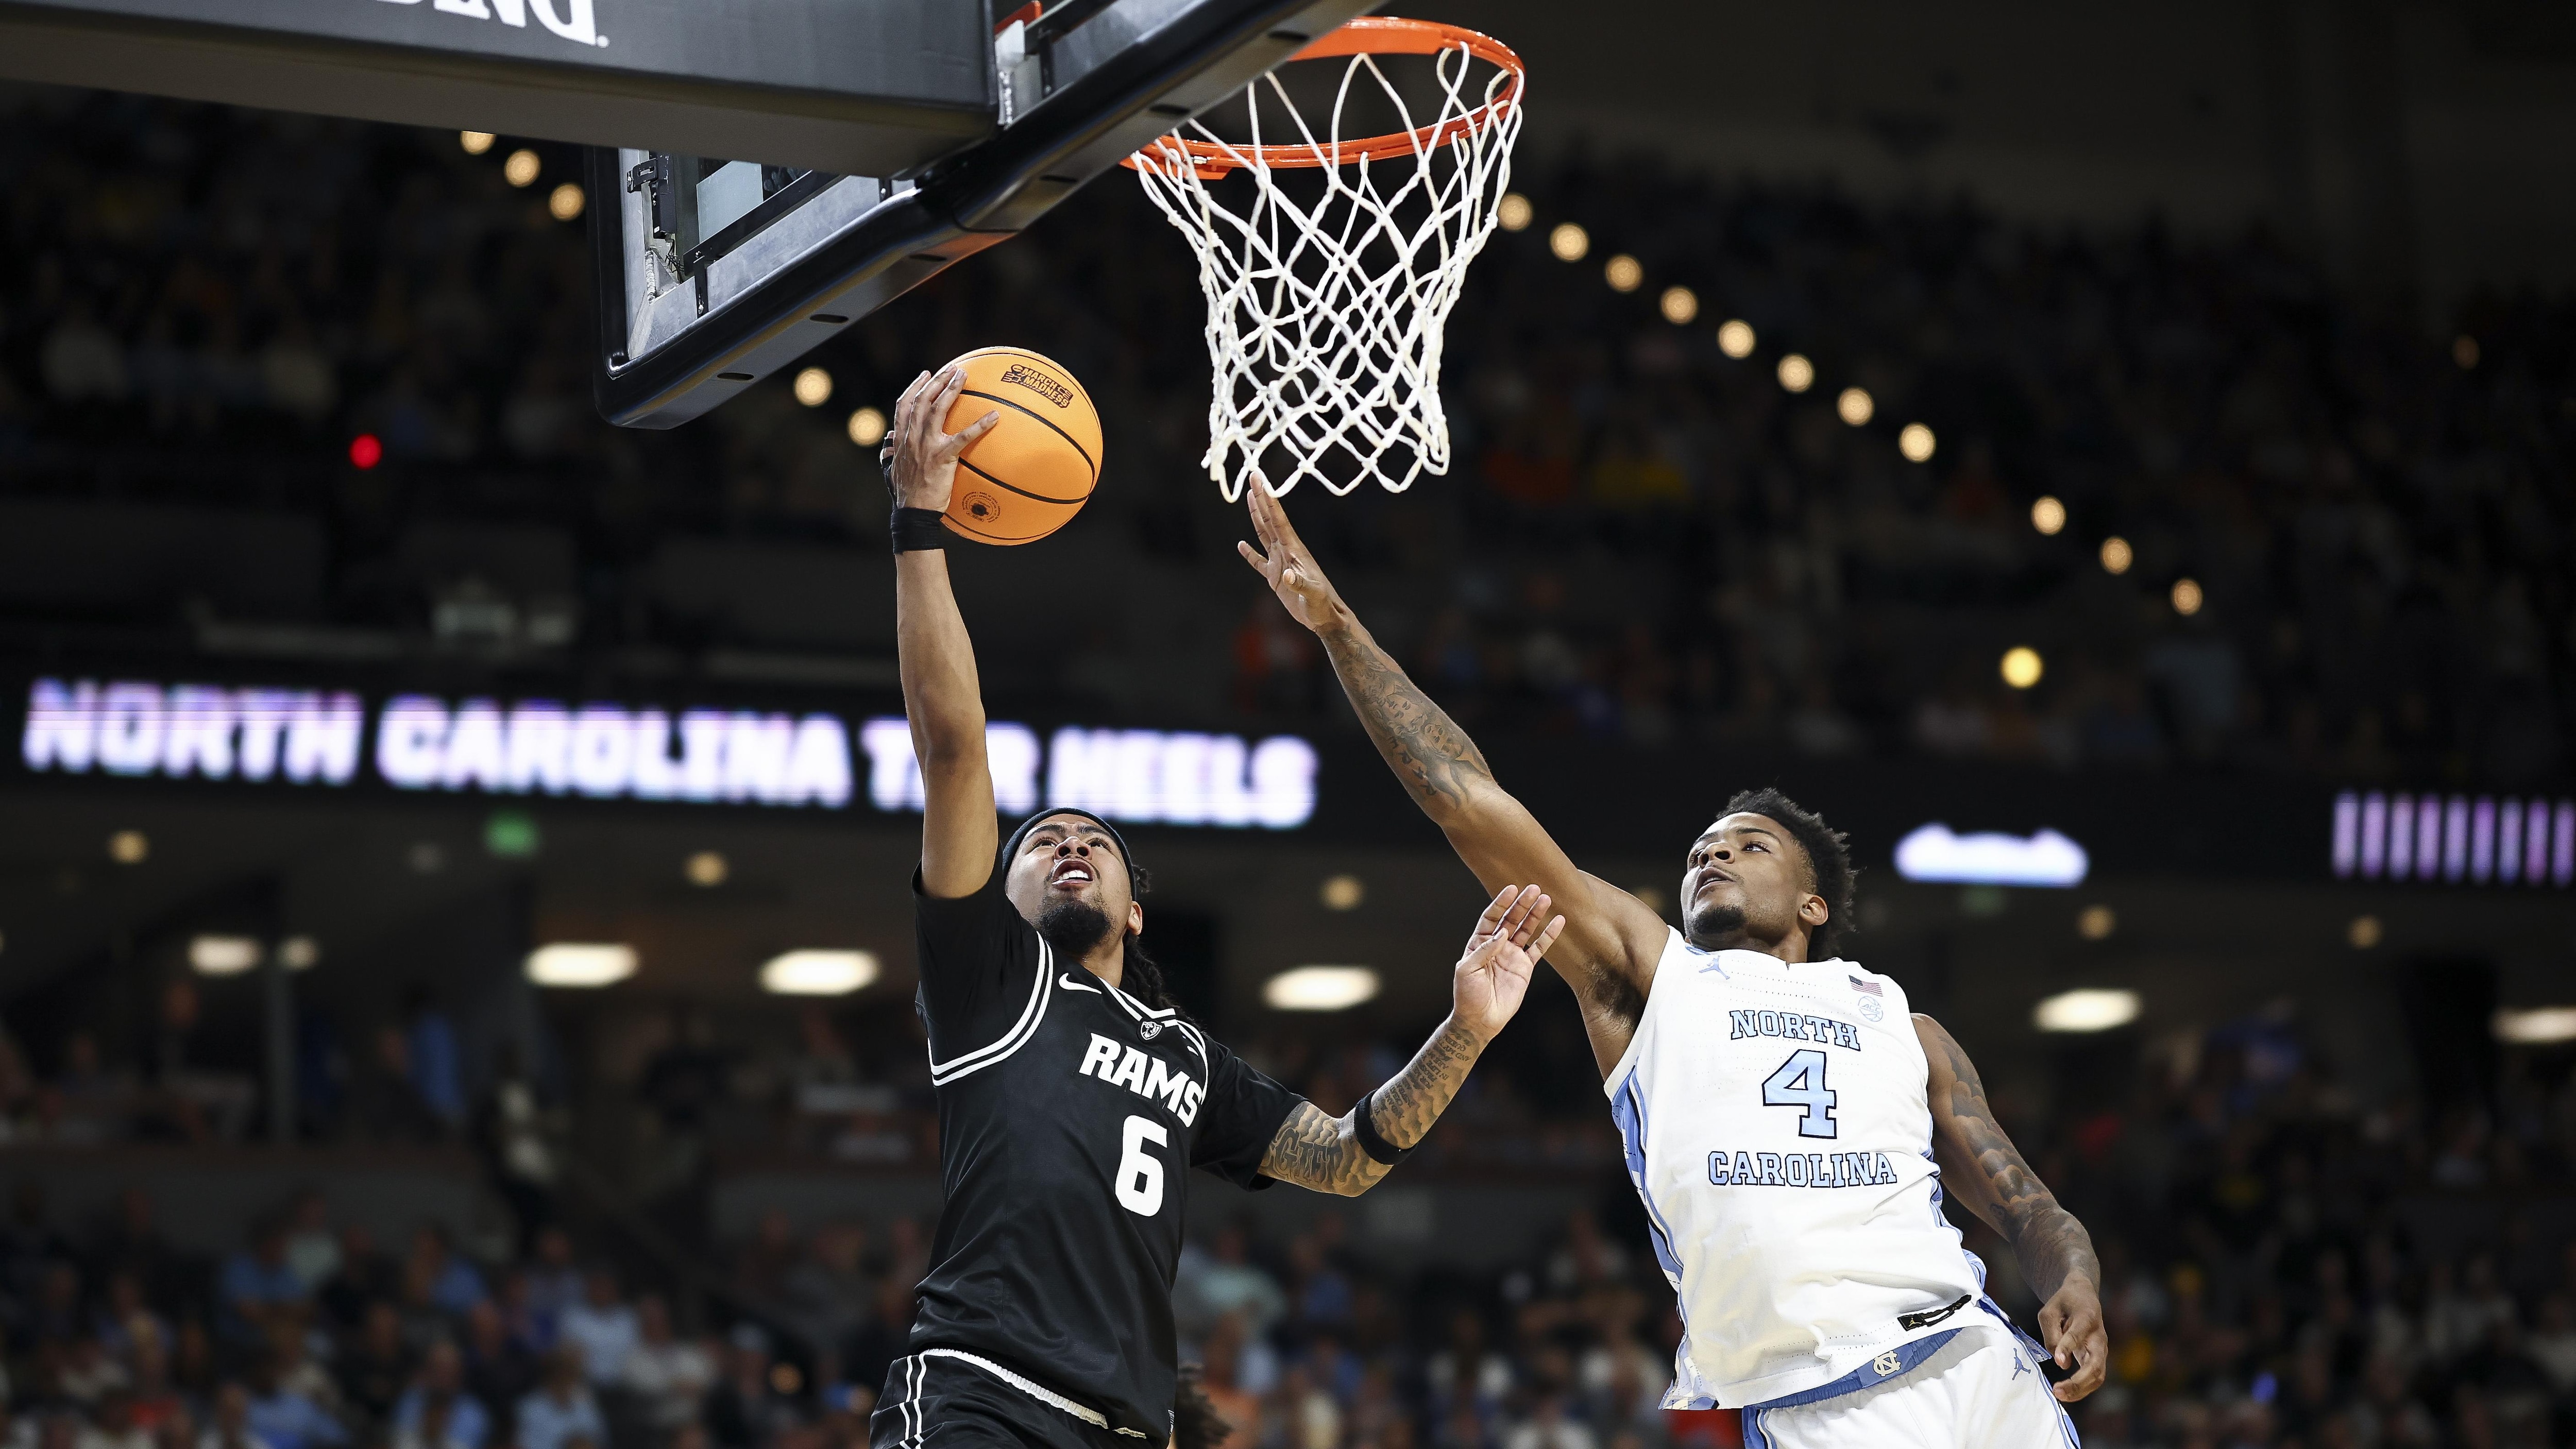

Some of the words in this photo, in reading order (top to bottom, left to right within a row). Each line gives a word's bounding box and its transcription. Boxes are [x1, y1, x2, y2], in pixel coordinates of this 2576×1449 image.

[1022, 368, 1058, 388] MARCH
[1023, 377, 1069, 406] MADNESS
[25, 681, 361, 783] NORTH
[378, 697, 851, 807] CAROLINA
[860, 719, 1040, 815] TR
[1048, 729, 1315, 826] HEELS
[1730, 1010, 1860, 1051] NORTH
[1079, 1032, 1202, 1128] RAMS
[1762, 1049, 1837, 1139] 4
[1115, 1115, 1167, 1217] 6
[1708, 1151, 1897, 1188] CAROLINA
